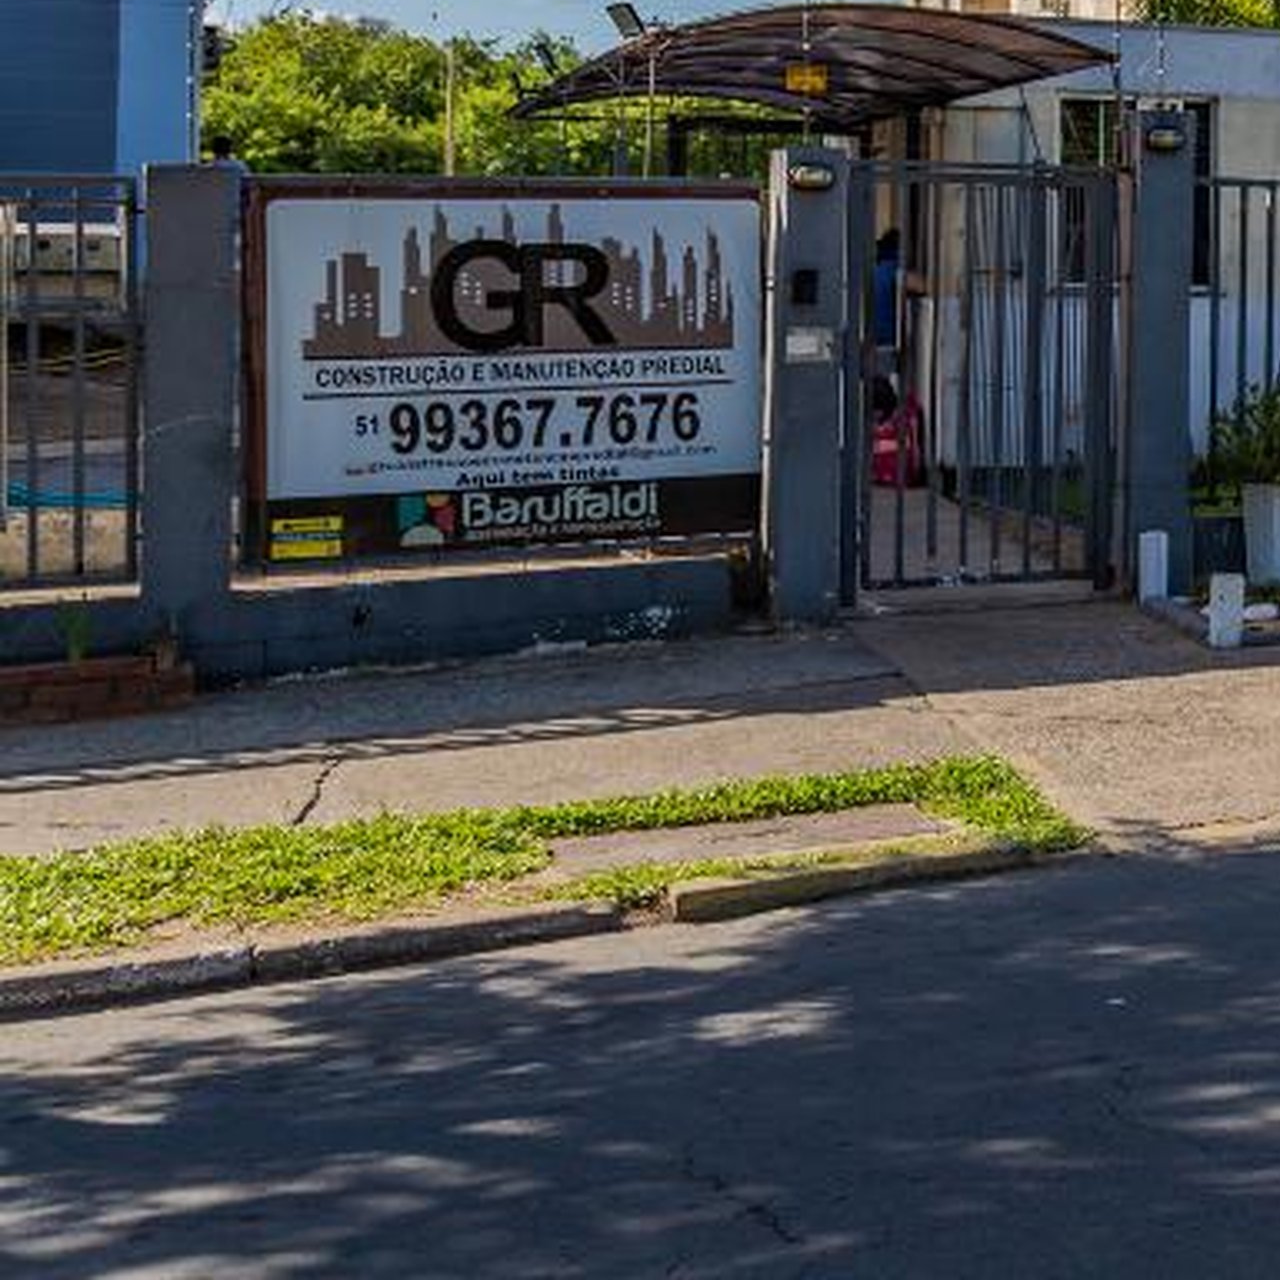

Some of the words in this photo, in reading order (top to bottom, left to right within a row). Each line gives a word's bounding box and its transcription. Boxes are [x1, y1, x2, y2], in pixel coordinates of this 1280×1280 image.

[430, 238, 619, 351] GR
[315, 360, 465, 389] CONSTRUÇÃO
[472, 363, 485, 382] E
[641, 354, 725, 376] PREDIAL
[355, 415, 379, 437] 51
[389, 392, 701, 455] 99367.7676
[456, 470, 505, 488] Aqui
[512, 468, 554, 484] tem
[461, 481, 660, 528] Baruffaldi
